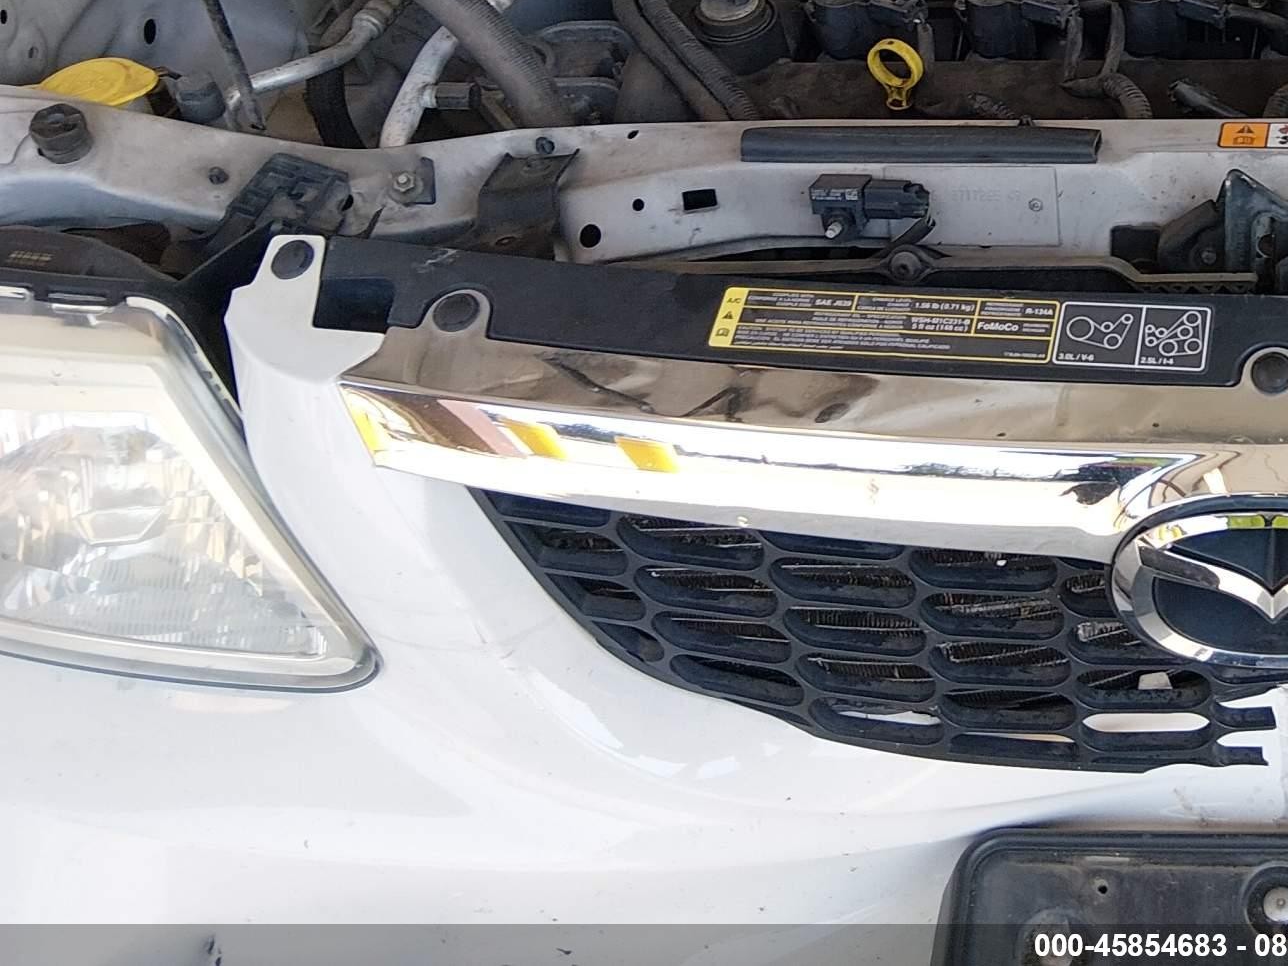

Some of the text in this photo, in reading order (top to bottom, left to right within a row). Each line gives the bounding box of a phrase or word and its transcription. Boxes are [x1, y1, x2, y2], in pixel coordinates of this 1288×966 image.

[815, 298, 832, 306] SAE
[940, 302, 959, 311] (0.71
[960, 303, 975, 312] kg)
[977, 322, 1019, 331] FoMoCo
